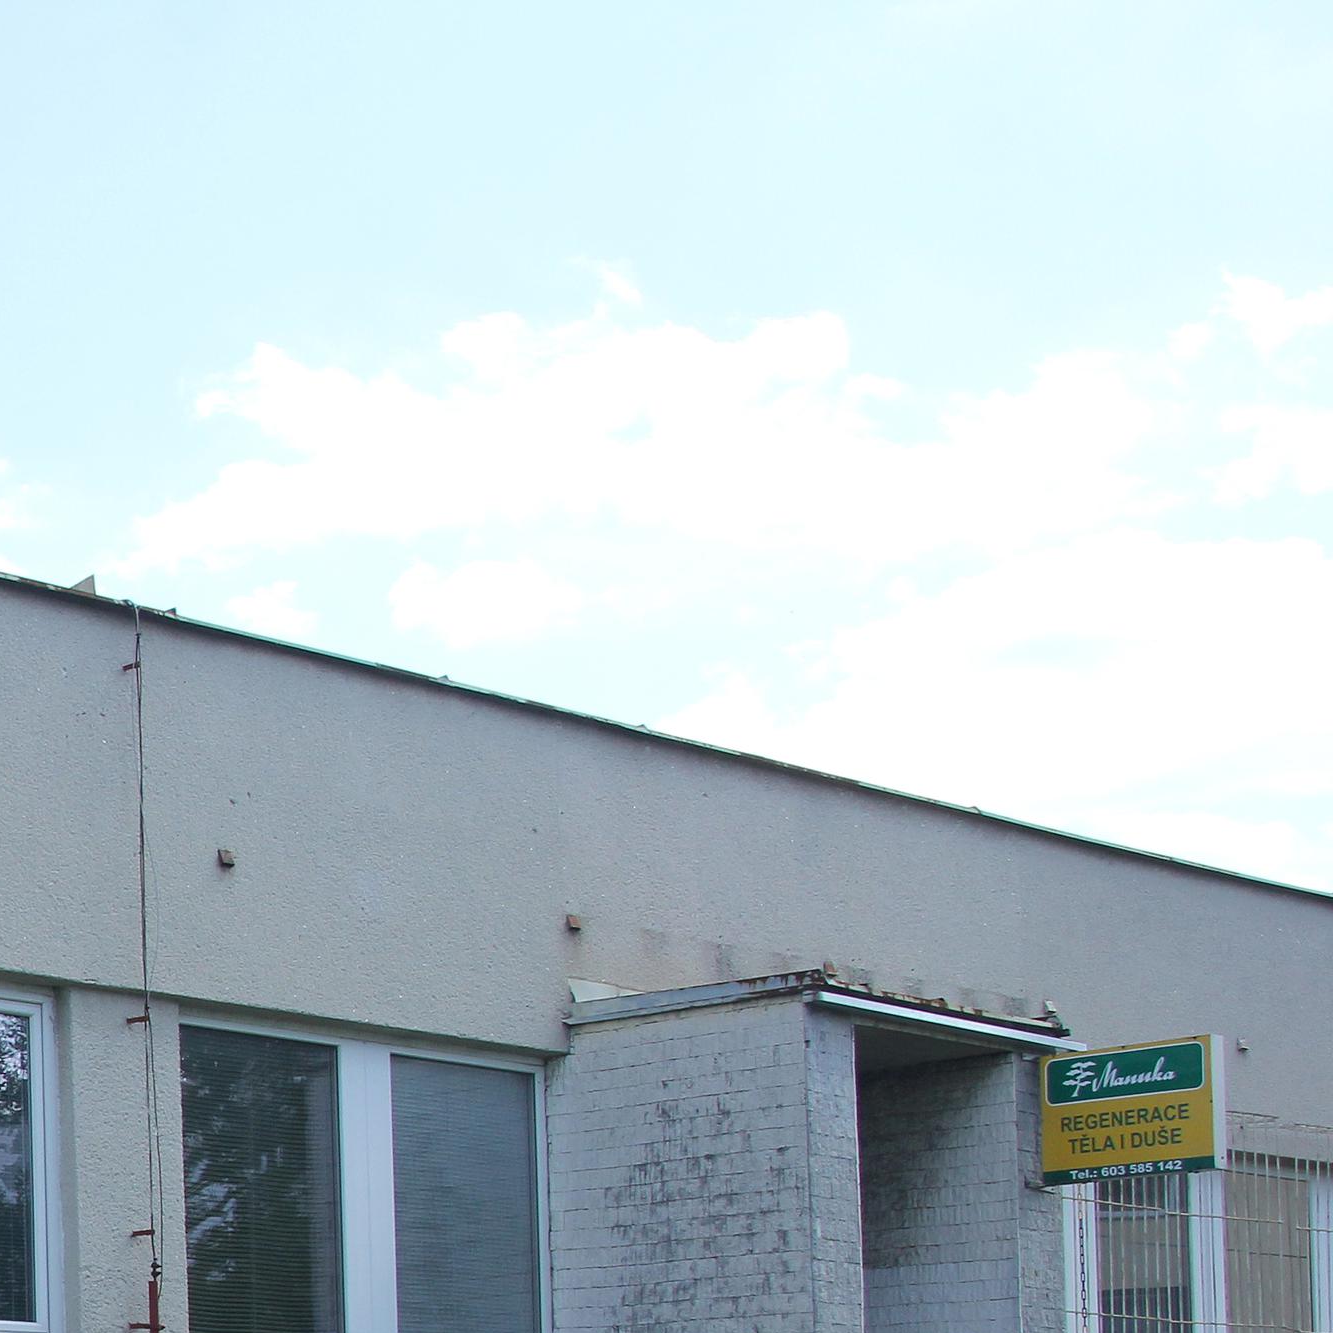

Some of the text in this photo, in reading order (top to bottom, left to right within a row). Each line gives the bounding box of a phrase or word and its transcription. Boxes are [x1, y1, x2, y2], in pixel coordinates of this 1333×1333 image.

[1092, 1056, 1177, 1092] Manuka
[1061, 1103, 1190, 1132] REGENERACE
[1069, 1134, 1115, 1154] TĚLA
[1131, 1126, 1182, 1147] DUŠE
[1070, 1160, 1183, 1180] Tel.: 603 585 142
